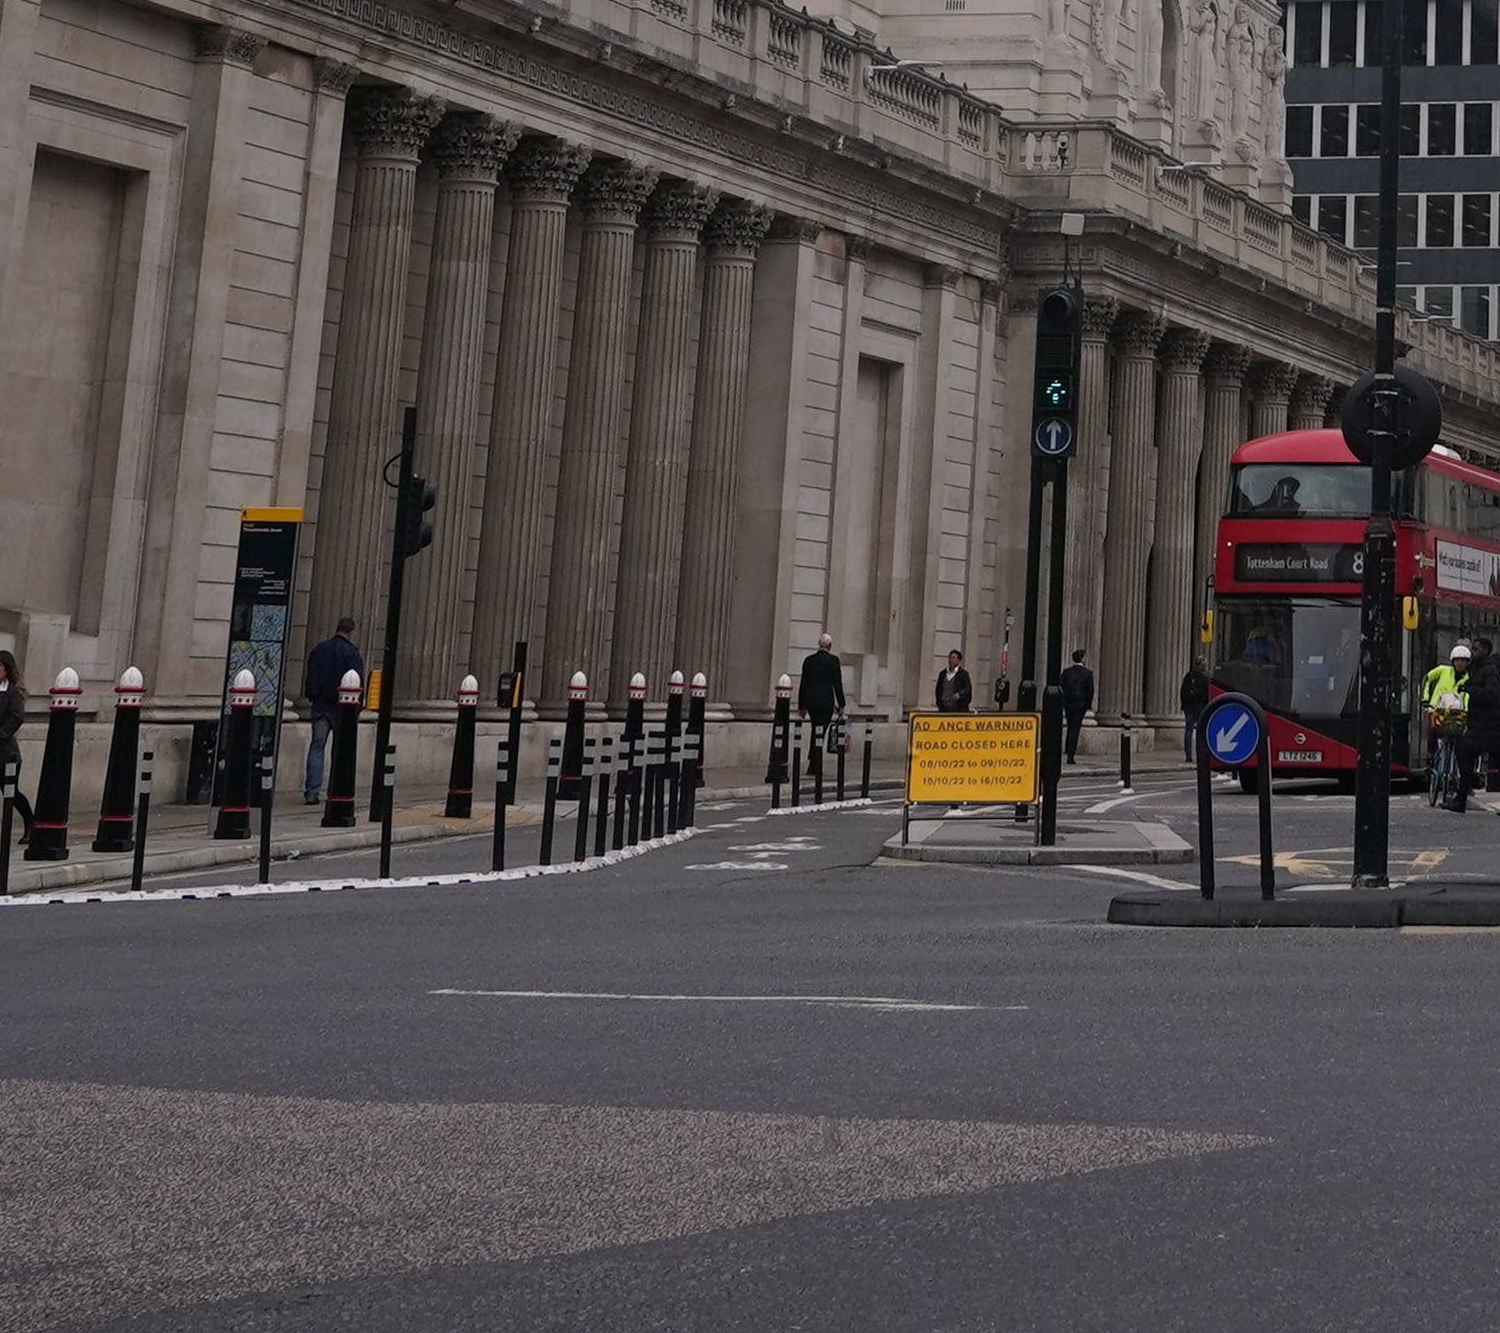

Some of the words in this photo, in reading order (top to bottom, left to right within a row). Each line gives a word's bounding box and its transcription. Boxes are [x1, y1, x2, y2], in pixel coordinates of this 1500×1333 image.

[1246, 556, 1286, 569] Tottenham
[1286, 557, 1308, 569] Court
[1309, 557, 1328, 569] Road
[914, 722, 971, 732] ADANCE
[975, 721, 1033, 732] WARNING
[916, 741, 948, 750] ROAD
[951, 740, 997, 750] CLOSED
[1000, 739, 1030, 749] HERE
[968, 760, 977, 768] to
[968, 777, 977, 785] to
